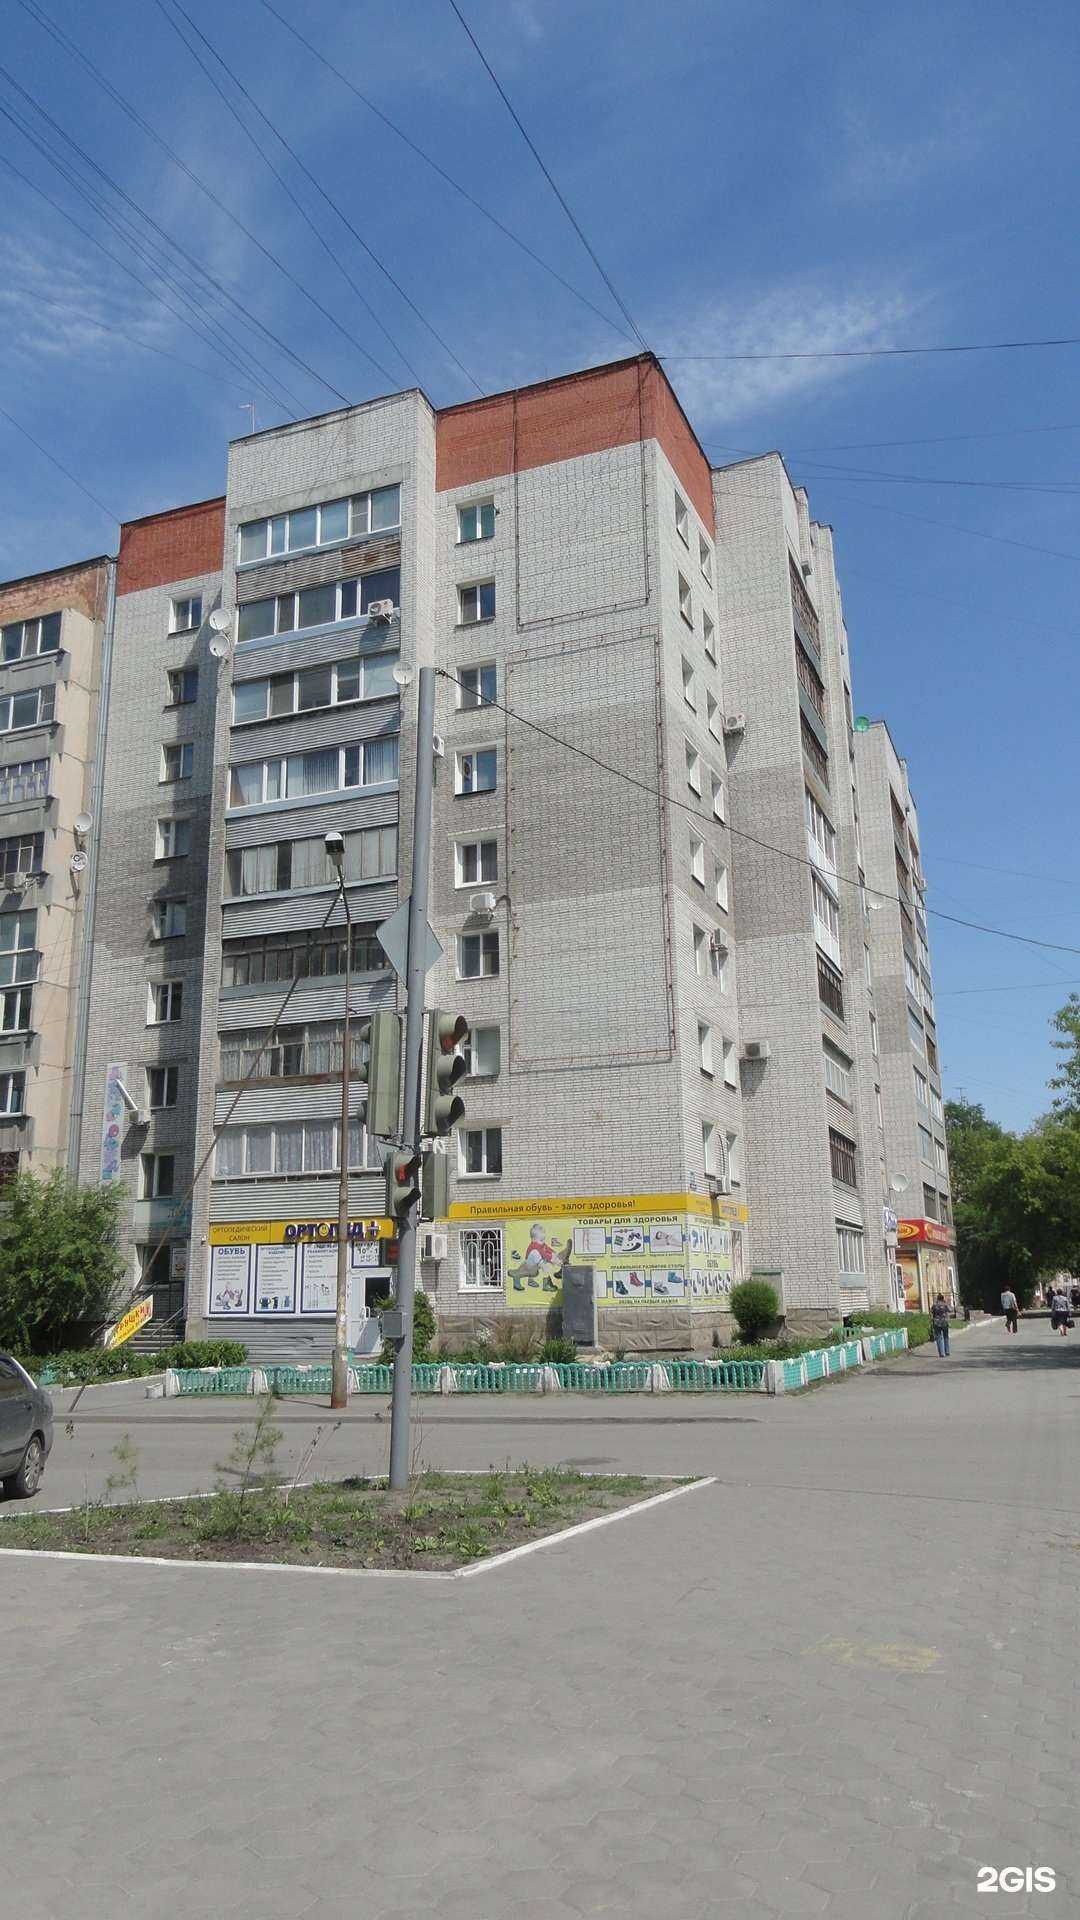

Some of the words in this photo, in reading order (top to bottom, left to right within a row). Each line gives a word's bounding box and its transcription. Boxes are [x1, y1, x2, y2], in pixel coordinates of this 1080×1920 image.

[470, 1206, 524, 1215] Правильная
[526, 1203, 553, 1213] обувь
[561, 1202, 585, 1211] залог
[589, 1200, 636, 1211] здоровья!
[633, 1215, 678, 1225] ЗДОРОВЬЯ
[212, 1225, 268, 1234] ОРТОПЕДИЧЕСКИЙ
[217, 1247, 246, 1255] ОБУВЬ
